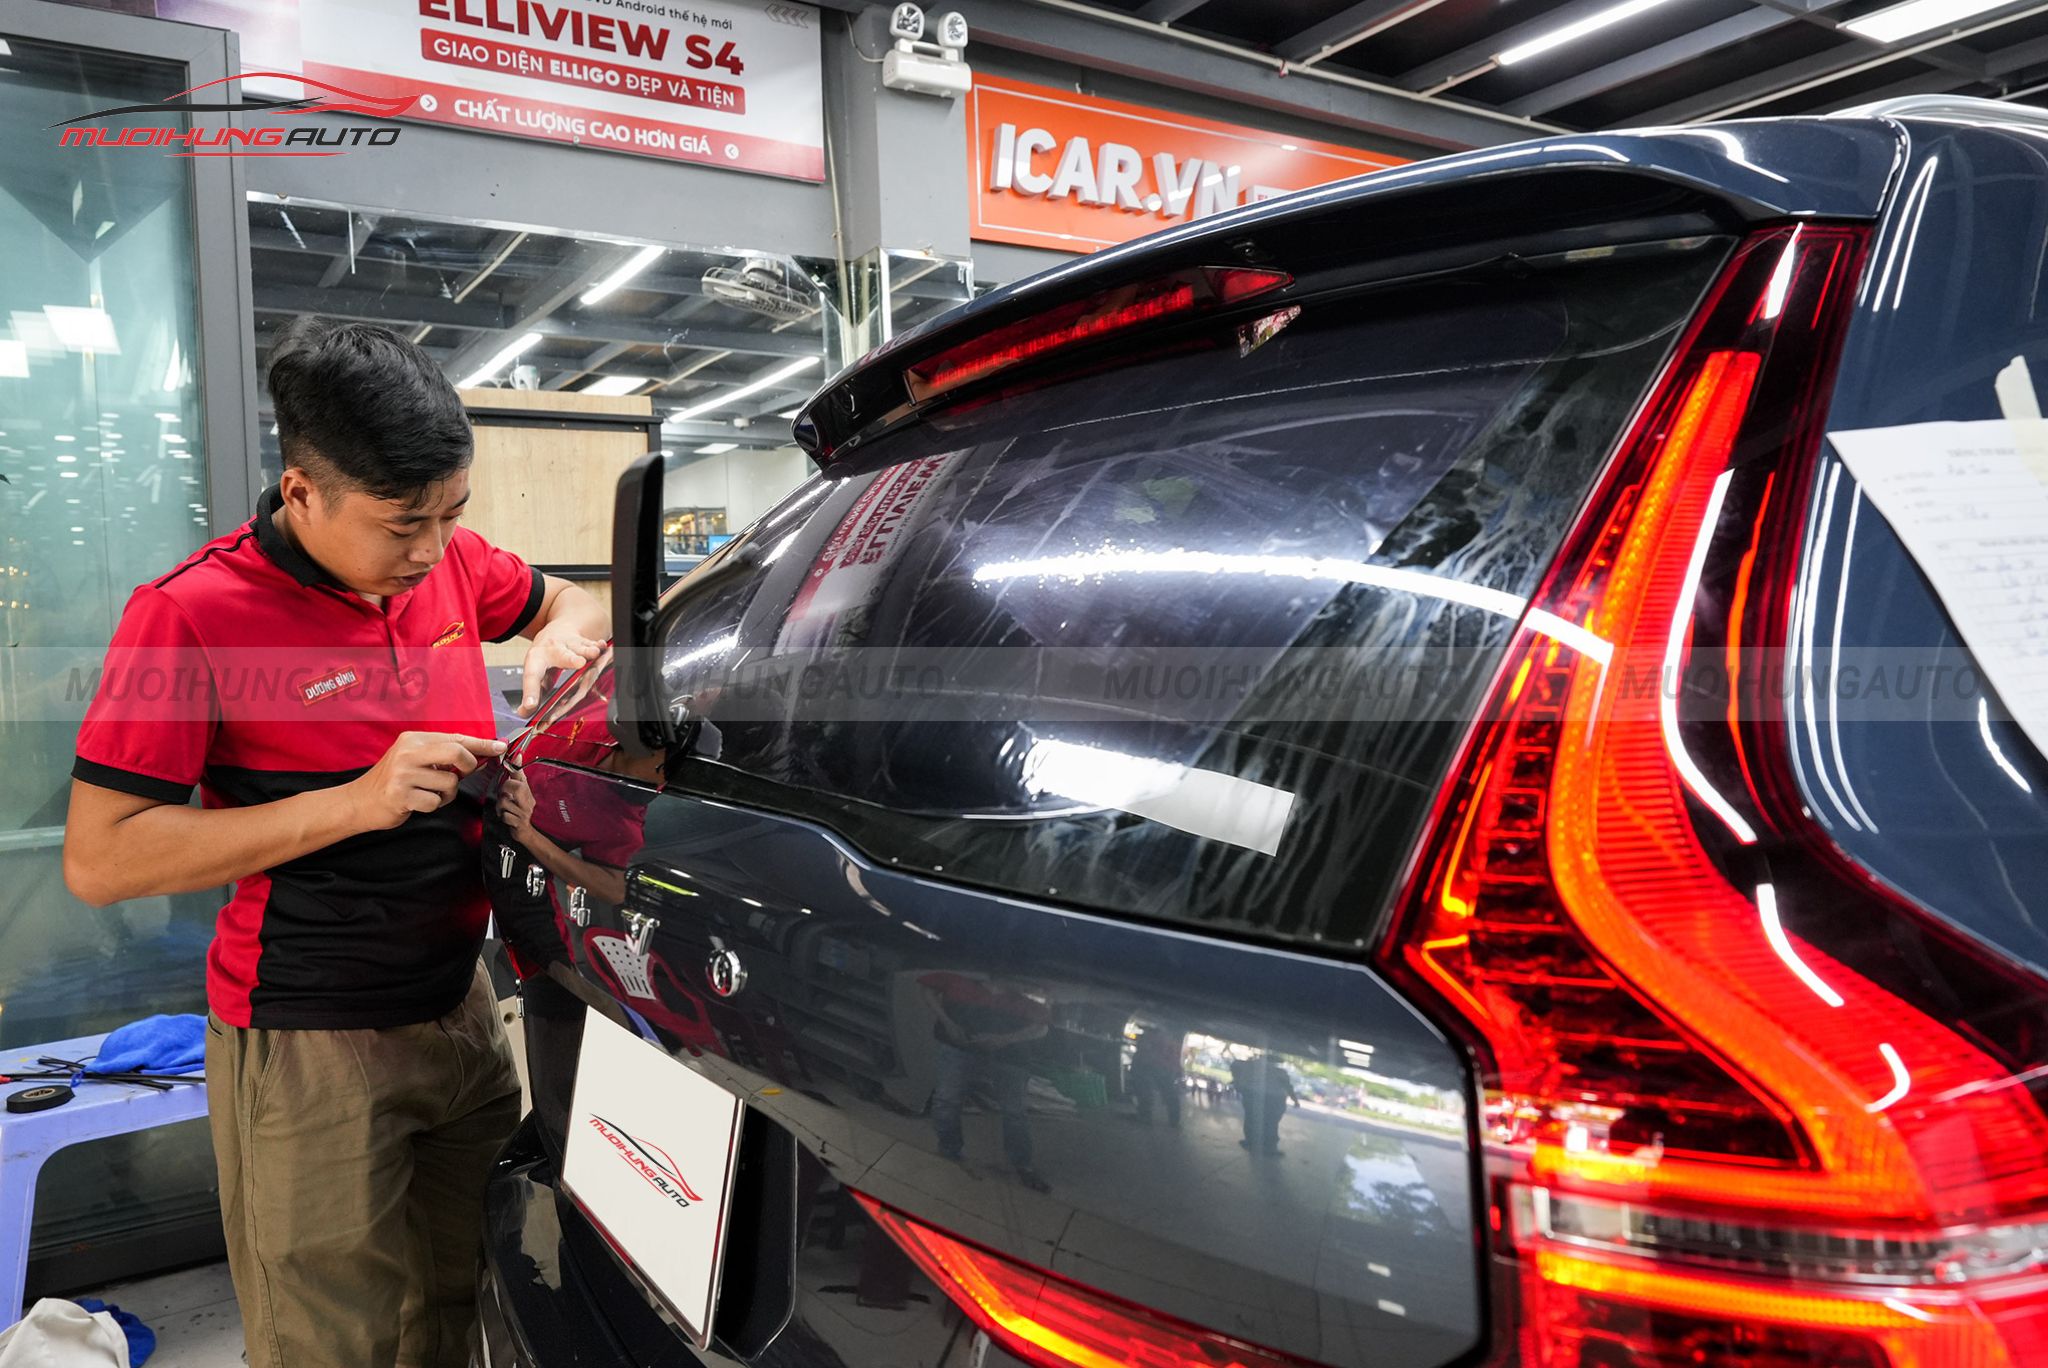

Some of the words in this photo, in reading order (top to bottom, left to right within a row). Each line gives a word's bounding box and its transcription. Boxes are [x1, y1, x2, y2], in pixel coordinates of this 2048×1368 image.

[616, 0, 665, 17] Android
[669, 8, 690, 22] thế
[693, 14, 707, 28] hệ
[711, 19, 733, 31] mới
[433, 38, 490, 63] GIAO
[496, 50, 544, 74] DIỆN
[550, 59, 621, 87] ELLIGO
[626, 73, 663, 95] ĐẸP
[667, 79, 692, 100] VÀ
[696, 86, 735, 108] TIỆN
[685, 34, 745, 76] S4
[454, 98, 510, 123] CHẤT
[515, 107, 585, 135] LƯỢNG
[590, 121, 630, 143] CAO
[634, 127, 676, 150] HƠN
[679, 131, 713, 156] GIÁ
[991, 122, 1241, 218] ICAR.VN
